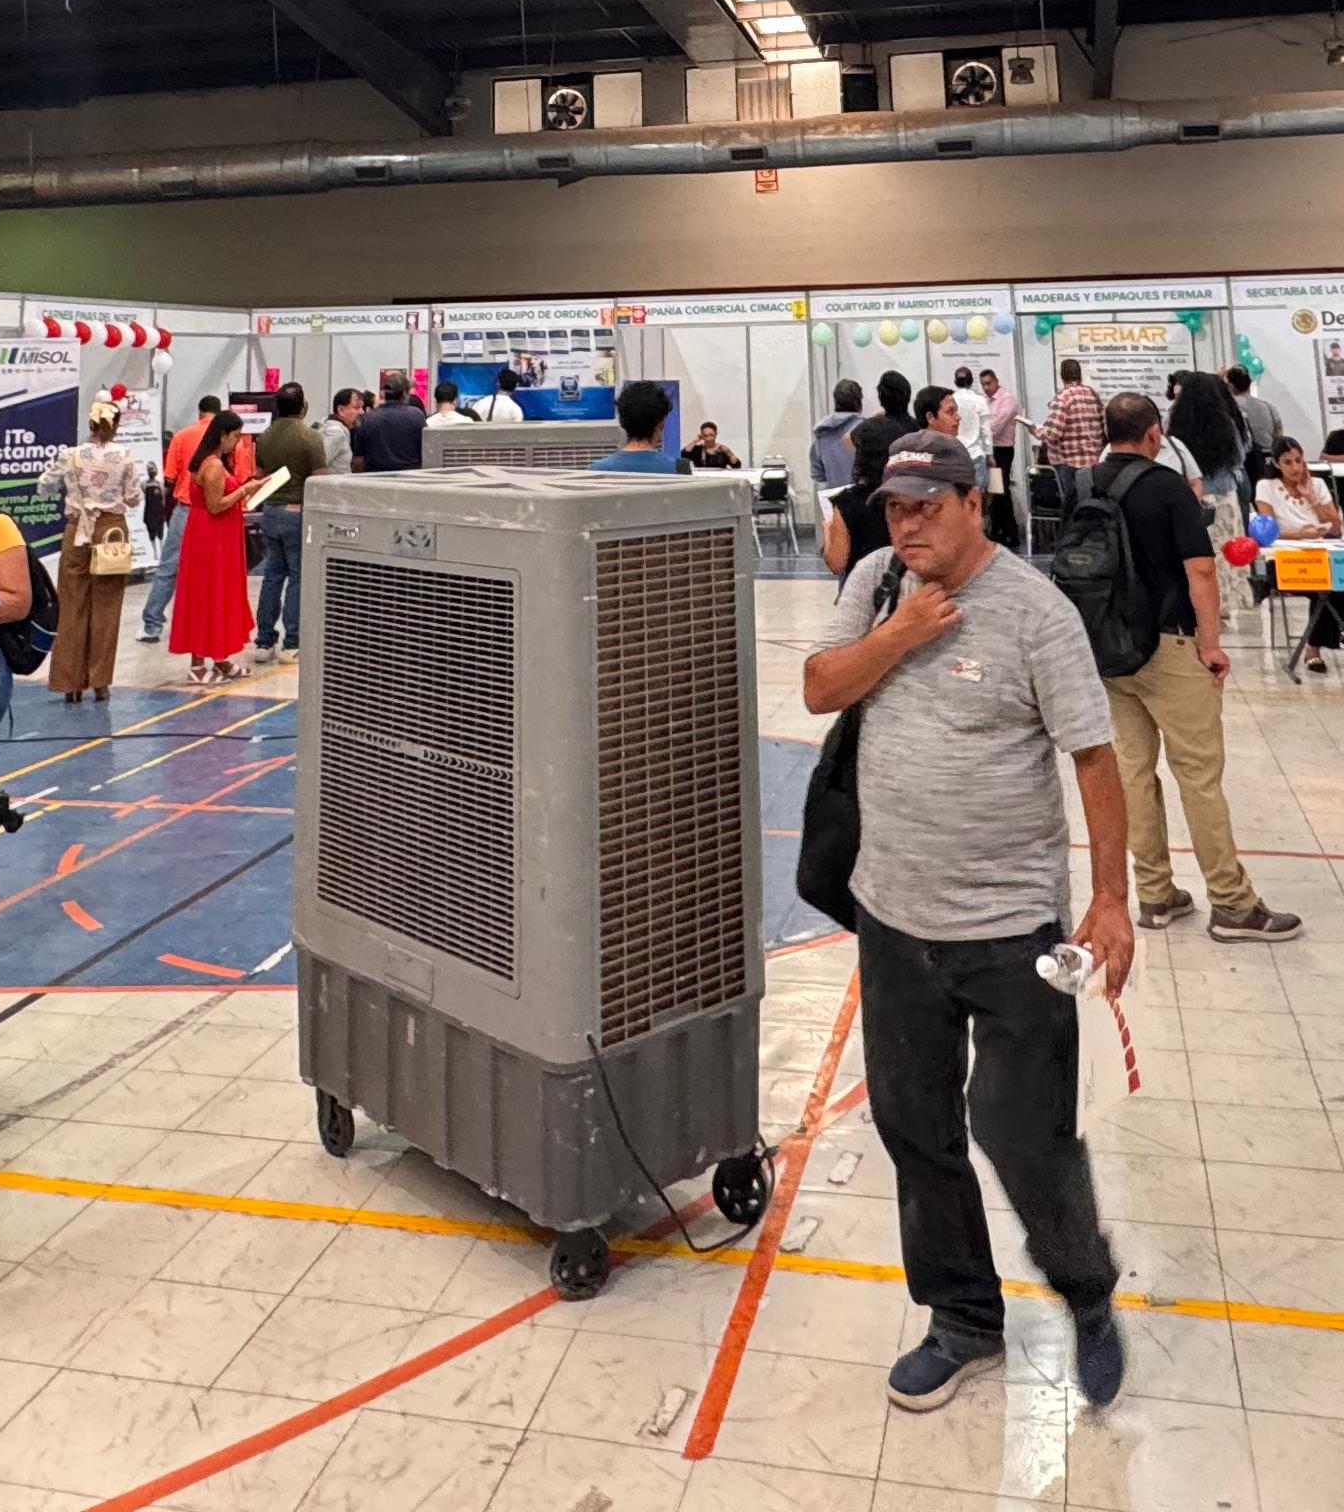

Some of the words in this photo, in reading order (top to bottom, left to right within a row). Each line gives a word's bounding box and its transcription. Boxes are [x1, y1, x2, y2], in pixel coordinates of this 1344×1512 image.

[1023, 292, 1080, 303] MADERAS
[1082, 292, 1091, 302] Y
[1094, 291, 1160, 301] EMPAQUES
[1163, 289, 1212, 300] FERMAR
[1310, 286, 1323, 295] DE
[1326, 285, 1339, 295] LA
[685, 304, 747, 315] COMERCIAL
[825, 302, 881, 313] COURTYARD
[884, 300, 896, 310] BY
[898, 299, 945, 309] MARRIOTT
[323, 315, 372, 324] OMERCIAL
[375, 314, 404, 324] OXXO
[449, 312, 493, 322] MADERO
[496, 311, 535, 321] EQUIPO
[538, 310, 551, 319] DE
[554, 308, 598, 319] ORDEÑO
[1078, 326, 1167, 343] FERMAR
[19, 351, 72, 364] MISOL
